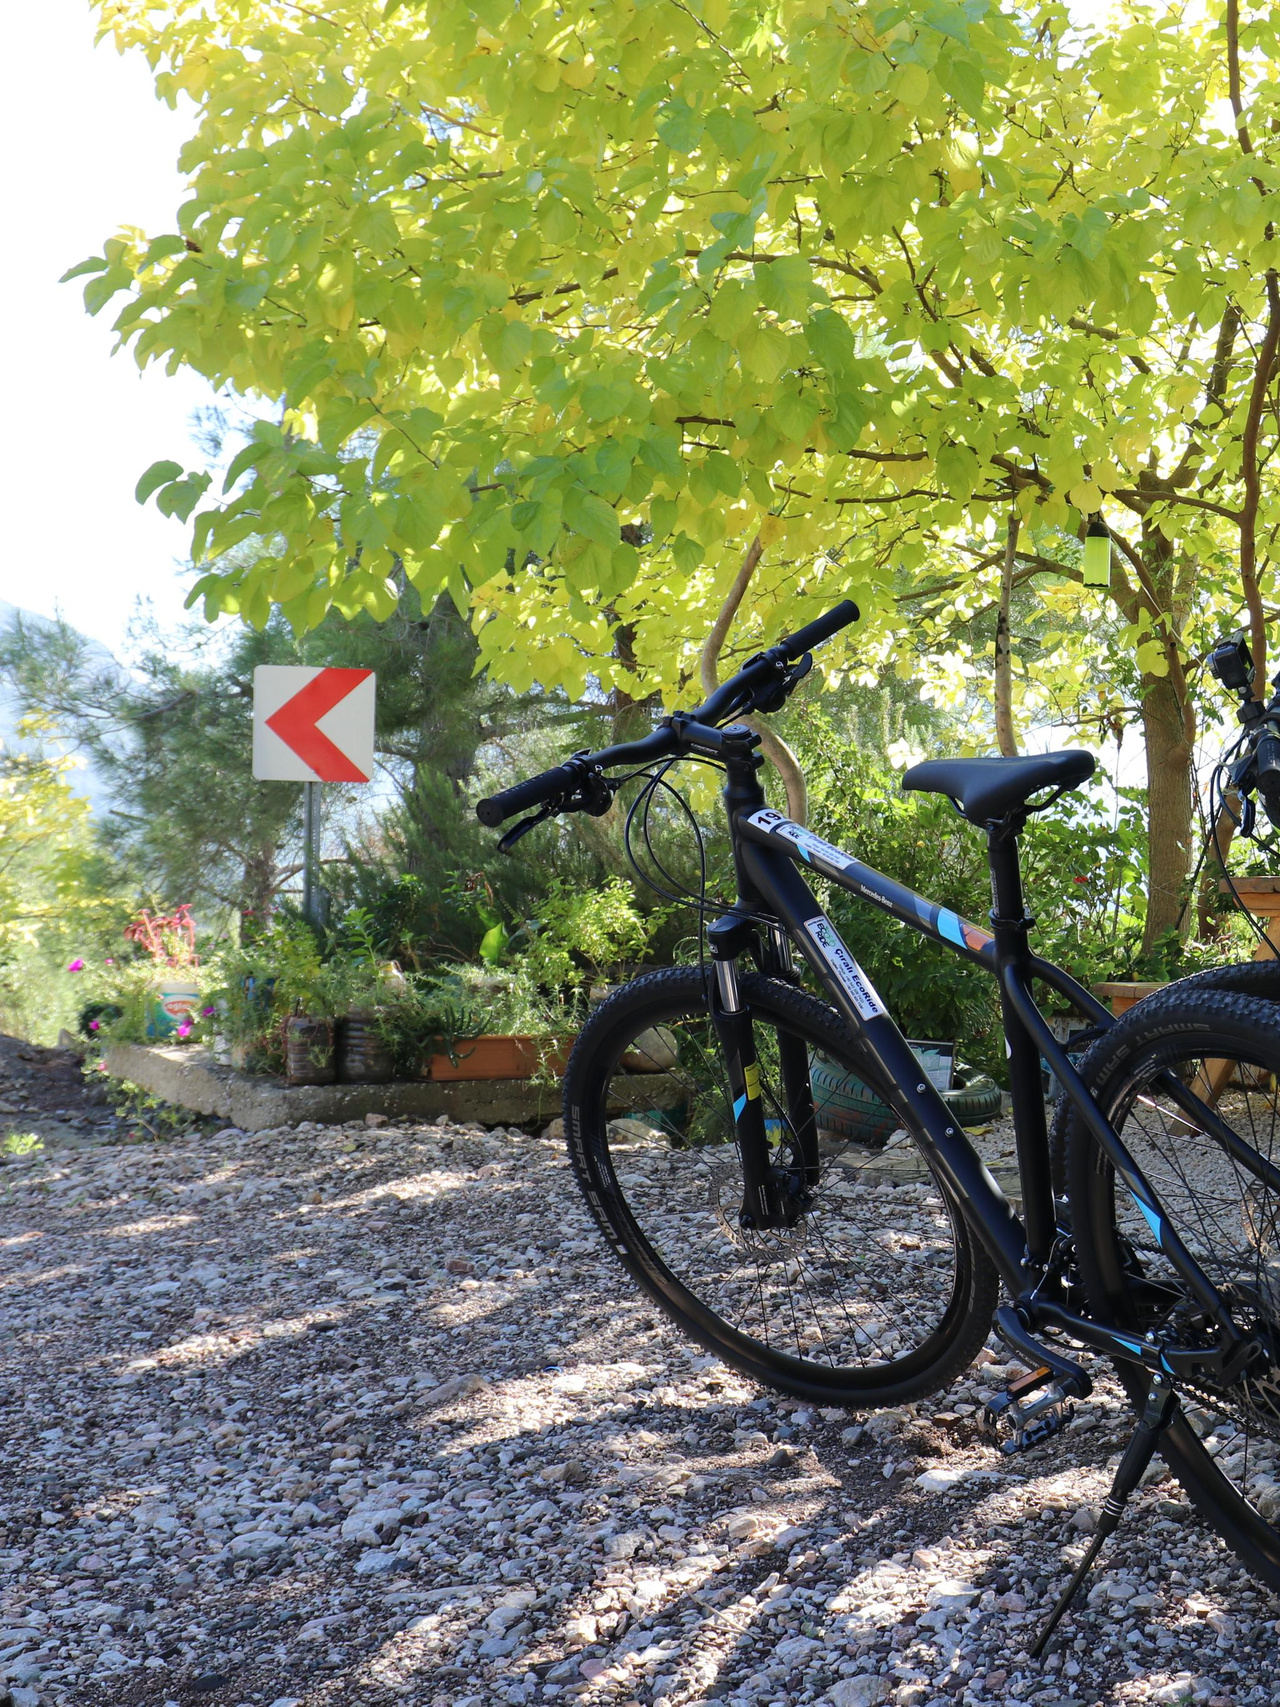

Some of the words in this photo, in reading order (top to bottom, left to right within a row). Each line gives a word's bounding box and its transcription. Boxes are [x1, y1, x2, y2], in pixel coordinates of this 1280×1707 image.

[757, 811, 782, 826] 19
[860, 884, 893, 908] Mercedes-Benz
[851, 974, 879, 1014] EcoRide
[571, 1104, 592, 1184] SMART
[587, 1190, 619, 1240] SAM
